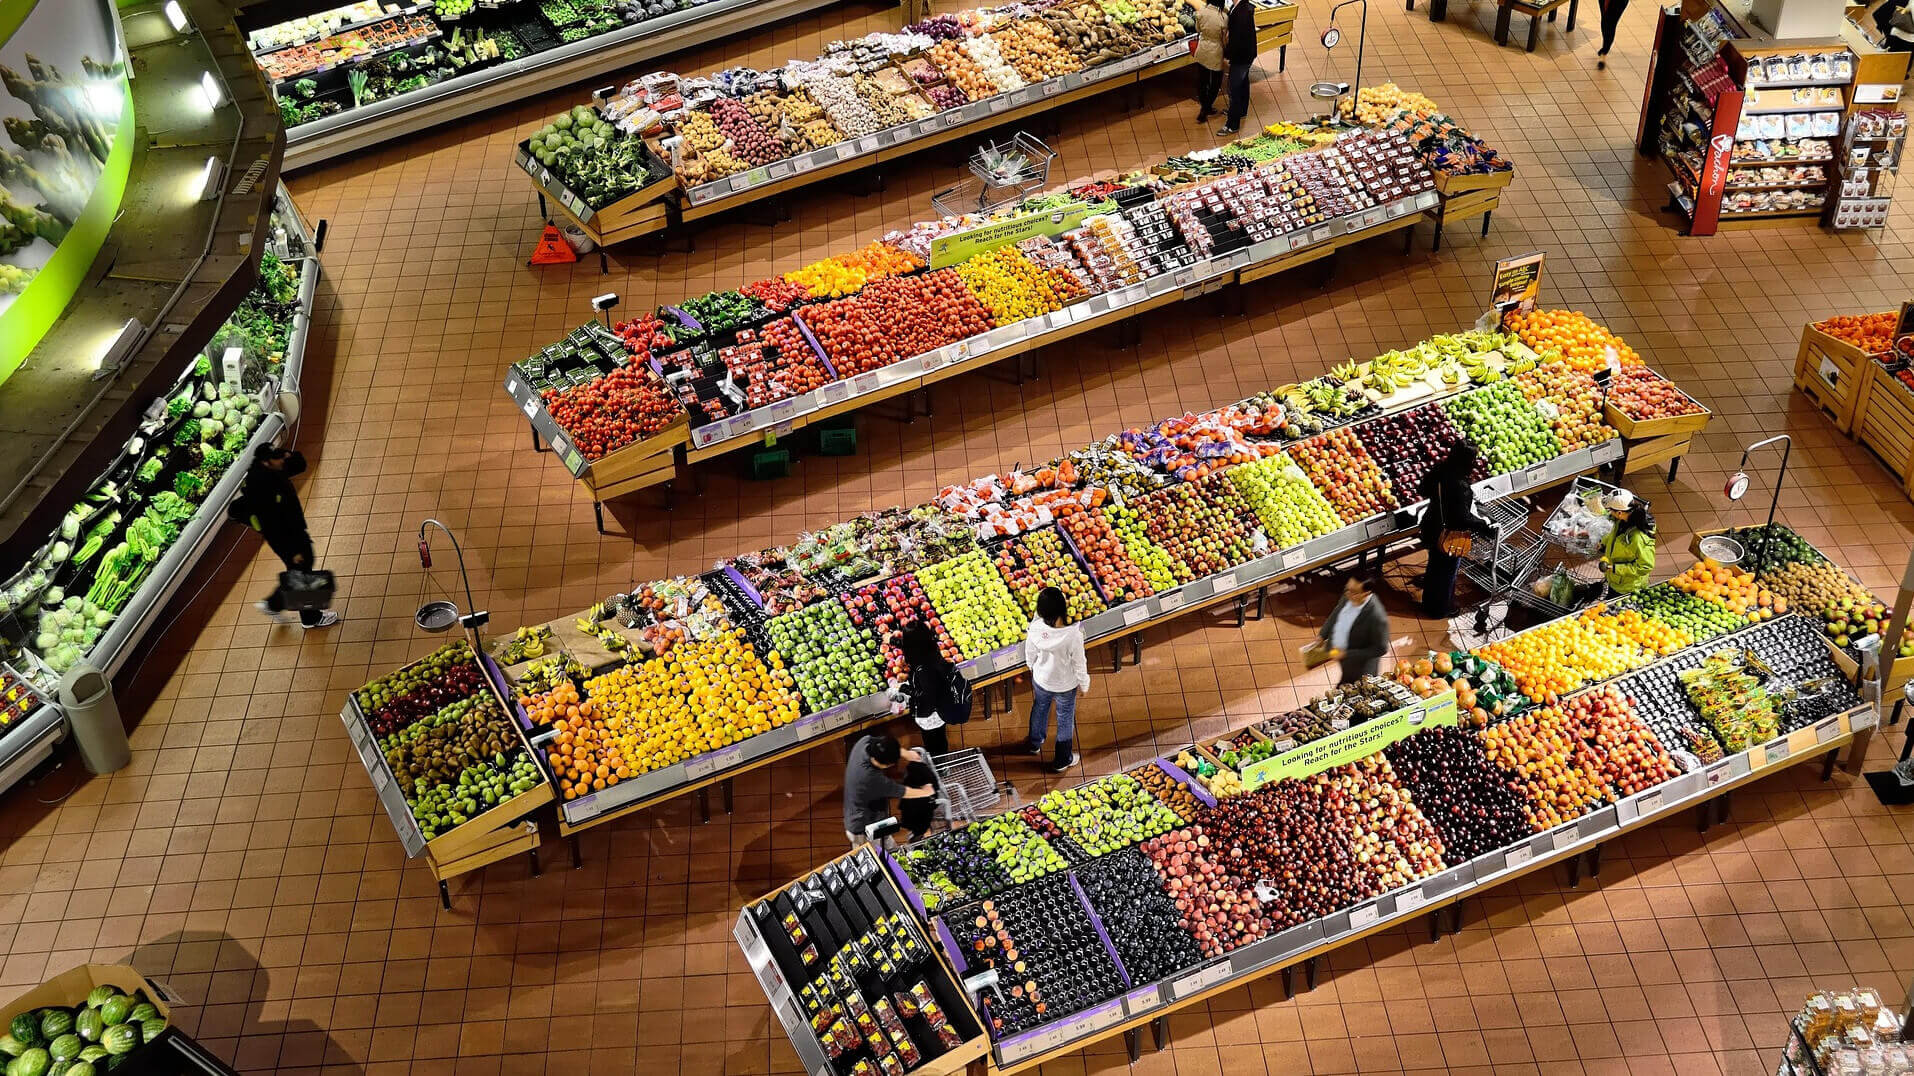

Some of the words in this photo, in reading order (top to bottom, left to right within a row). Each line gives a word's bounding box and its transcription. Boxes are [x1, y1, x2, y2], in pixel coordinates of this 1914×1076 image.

[1710, 134, 1731, 195] Vachon
[959, 231, 983, 242] Looking
[994, 223, 1023, 233] nutritious
[1024, 215, 1049, 226] choices?
[975, 234, 993, 244] Reach
[1016, 225, 1033, 234] Stars!
[1282, 750, 1314, 766] Looking
[1315, 746, 1326, 754] for
[1329, 731, 1368, 748] nutritious
[1370, 715, 1404, 733] choices?
[1304, 753, 1329, 766] Reach
[1331, 748, 1342, 756] for
[1344, 742, 1357, 751] the
[1360, 730, 1384, 745] Stars!
